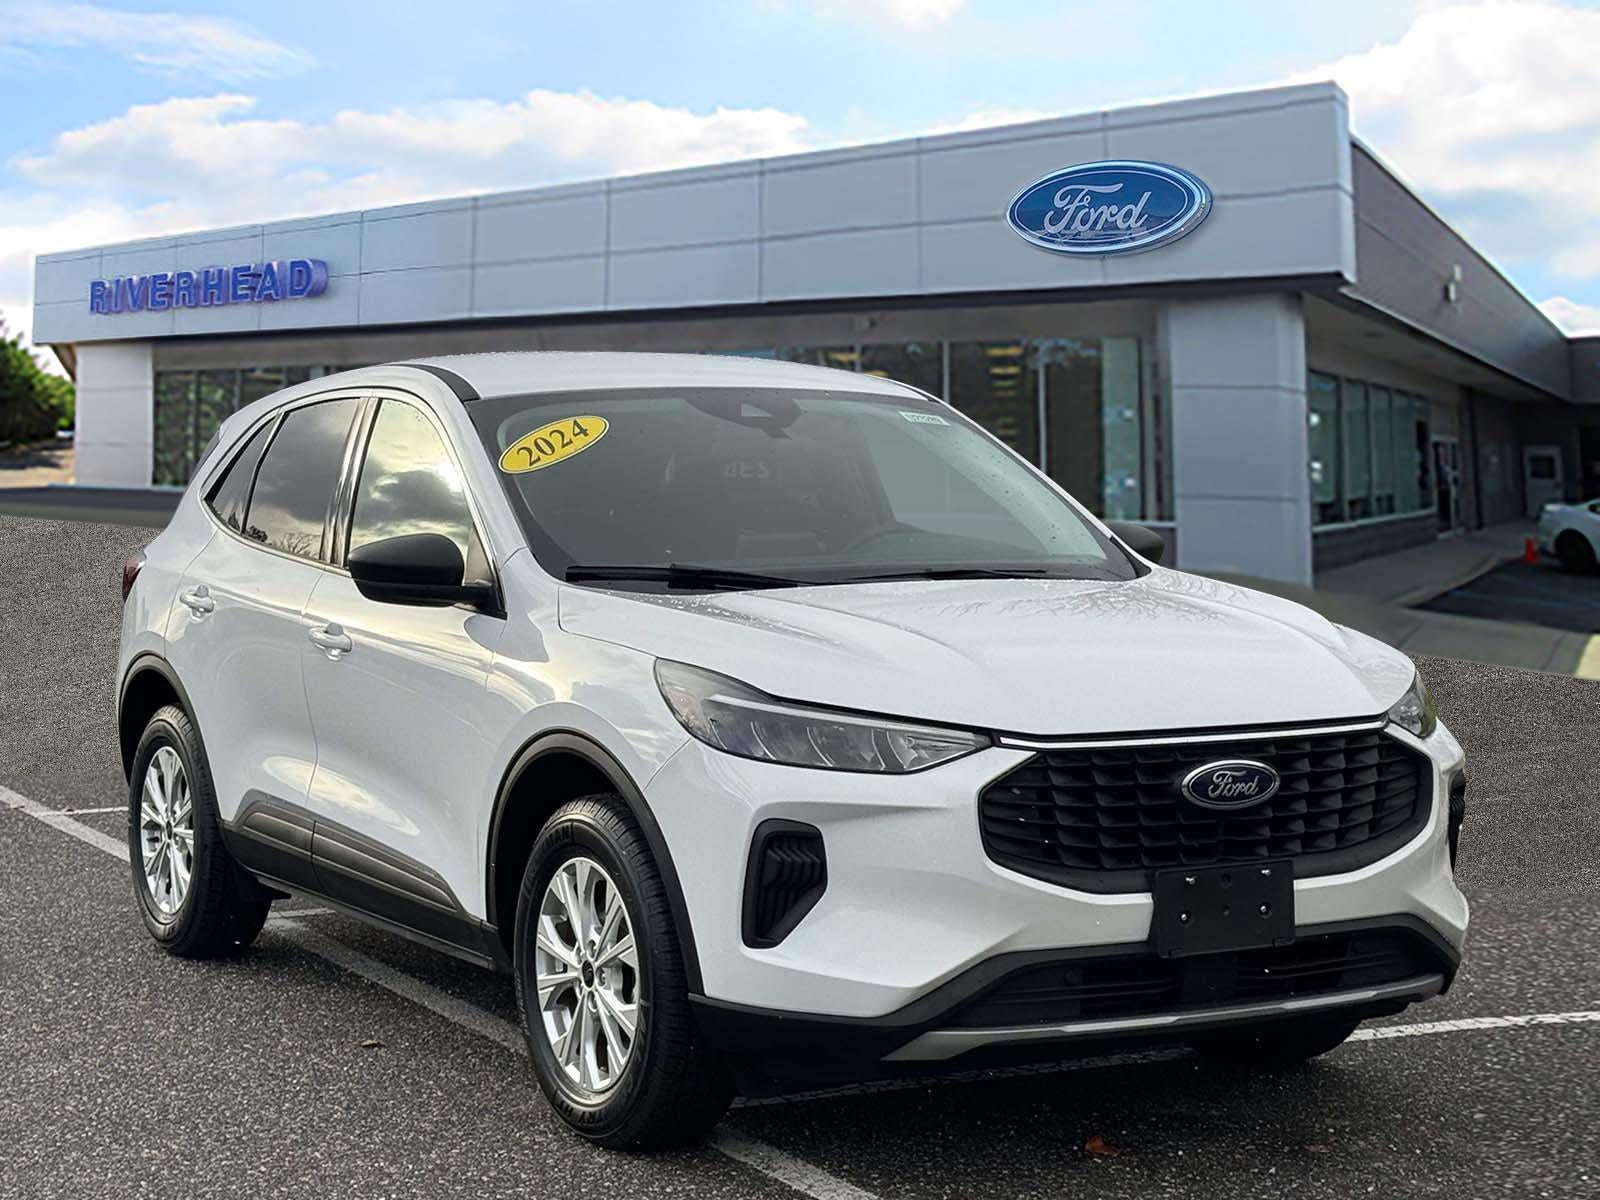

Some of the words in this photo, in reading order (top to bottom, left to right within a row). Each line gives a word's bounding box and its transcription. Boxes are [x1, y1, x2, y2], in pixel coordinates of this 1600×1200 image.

[1043, 182, 1152, 235] Ford
[89, 258, 326, 315] RIVERHEAD
[516, 419, 590, 467] 2024
[1208, 770, 1259, 798] Ford
